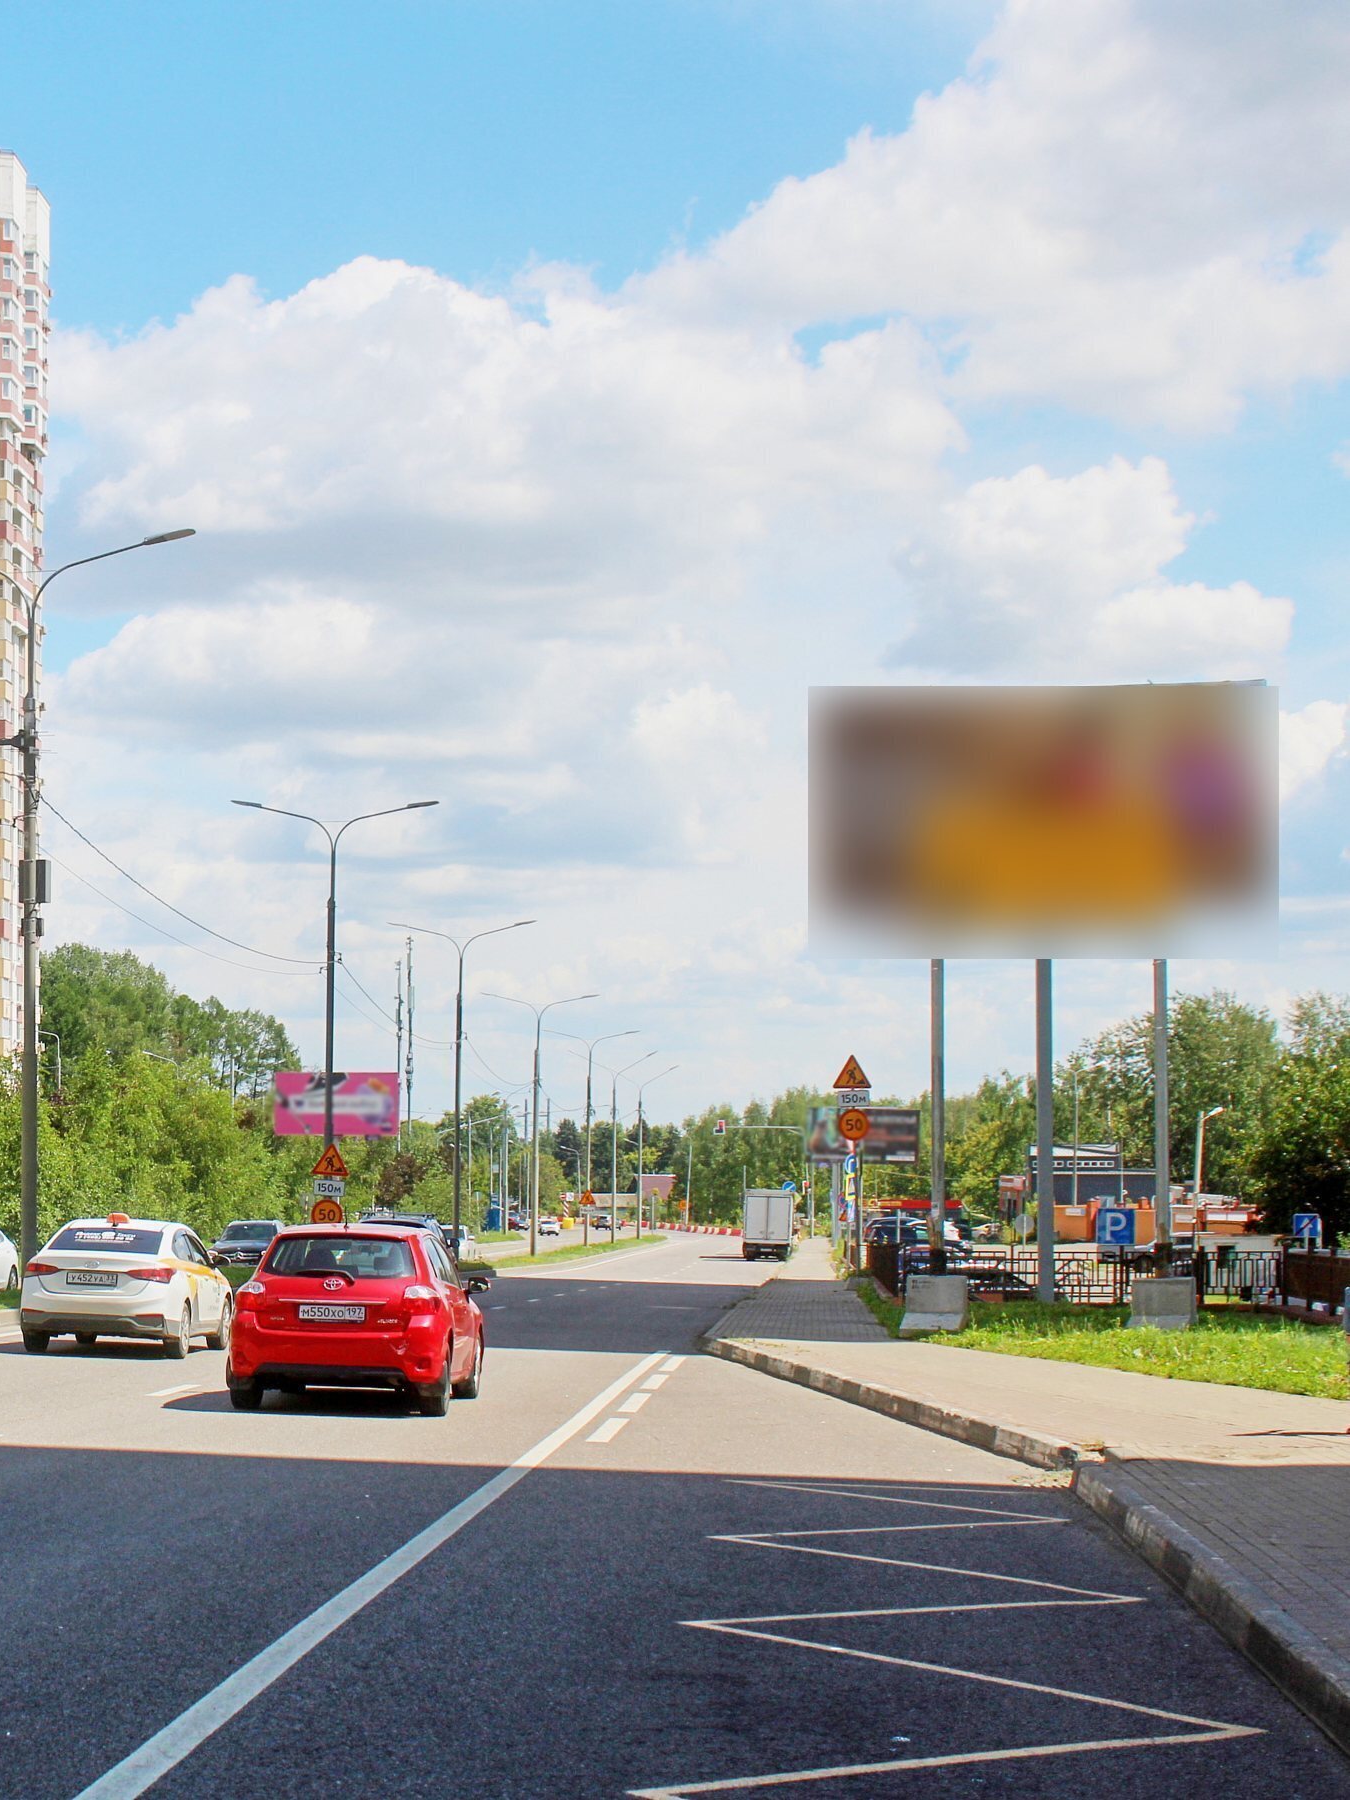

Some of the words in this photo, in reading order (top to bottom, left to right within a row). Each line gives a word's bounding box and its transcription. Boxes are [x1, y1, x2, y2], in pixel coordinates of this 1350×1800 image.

[841, 1093, 867, 1104] 150м
[845, 1118, 864, 1132] 50
[317, 1182, 342, 1194] 150м
[318, 1208, 336, 1222] 50
[1105, 1211, 1128, 1241] P
[346, 1307, 362, 1316] 197
